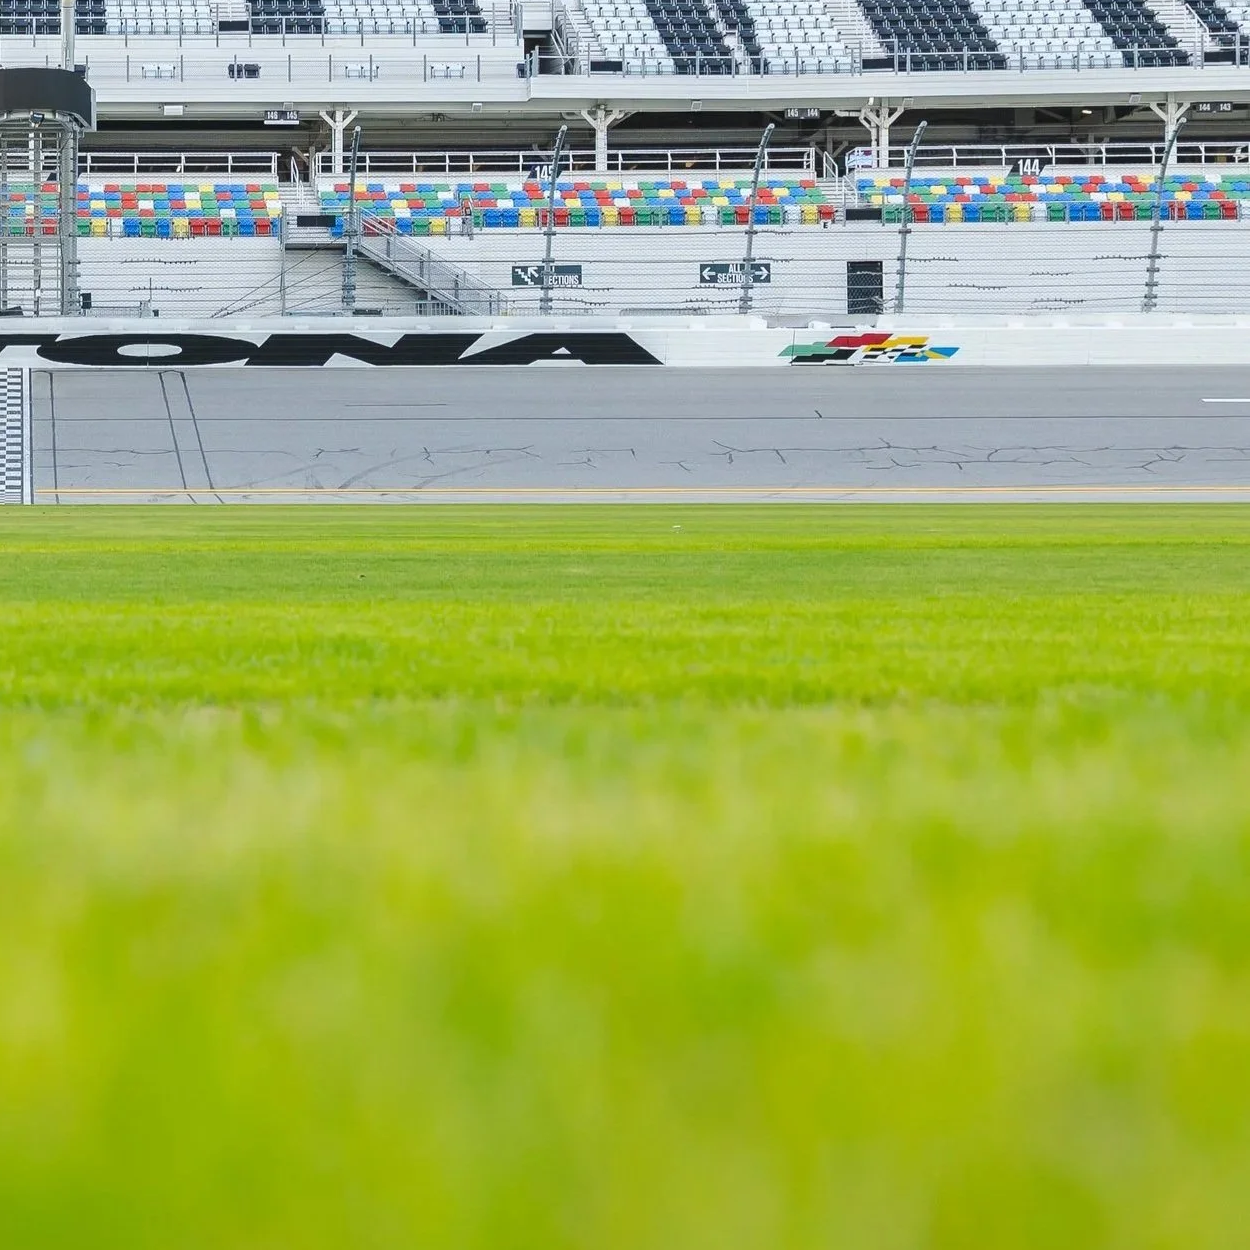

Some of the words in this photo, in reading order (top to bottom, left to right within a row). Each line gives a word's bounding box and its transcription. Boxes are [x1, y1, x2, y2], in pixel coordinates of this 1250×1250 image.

[787, 108, 799, 117] 145
[807, 108, 818, 117] 144
[1018, 158, 1040, 175] 144
[729, 264, 741, 273] ALL
[544, 275, 579, 285] ECTIONS
[717, 274, 754, 283] SECTIOS
